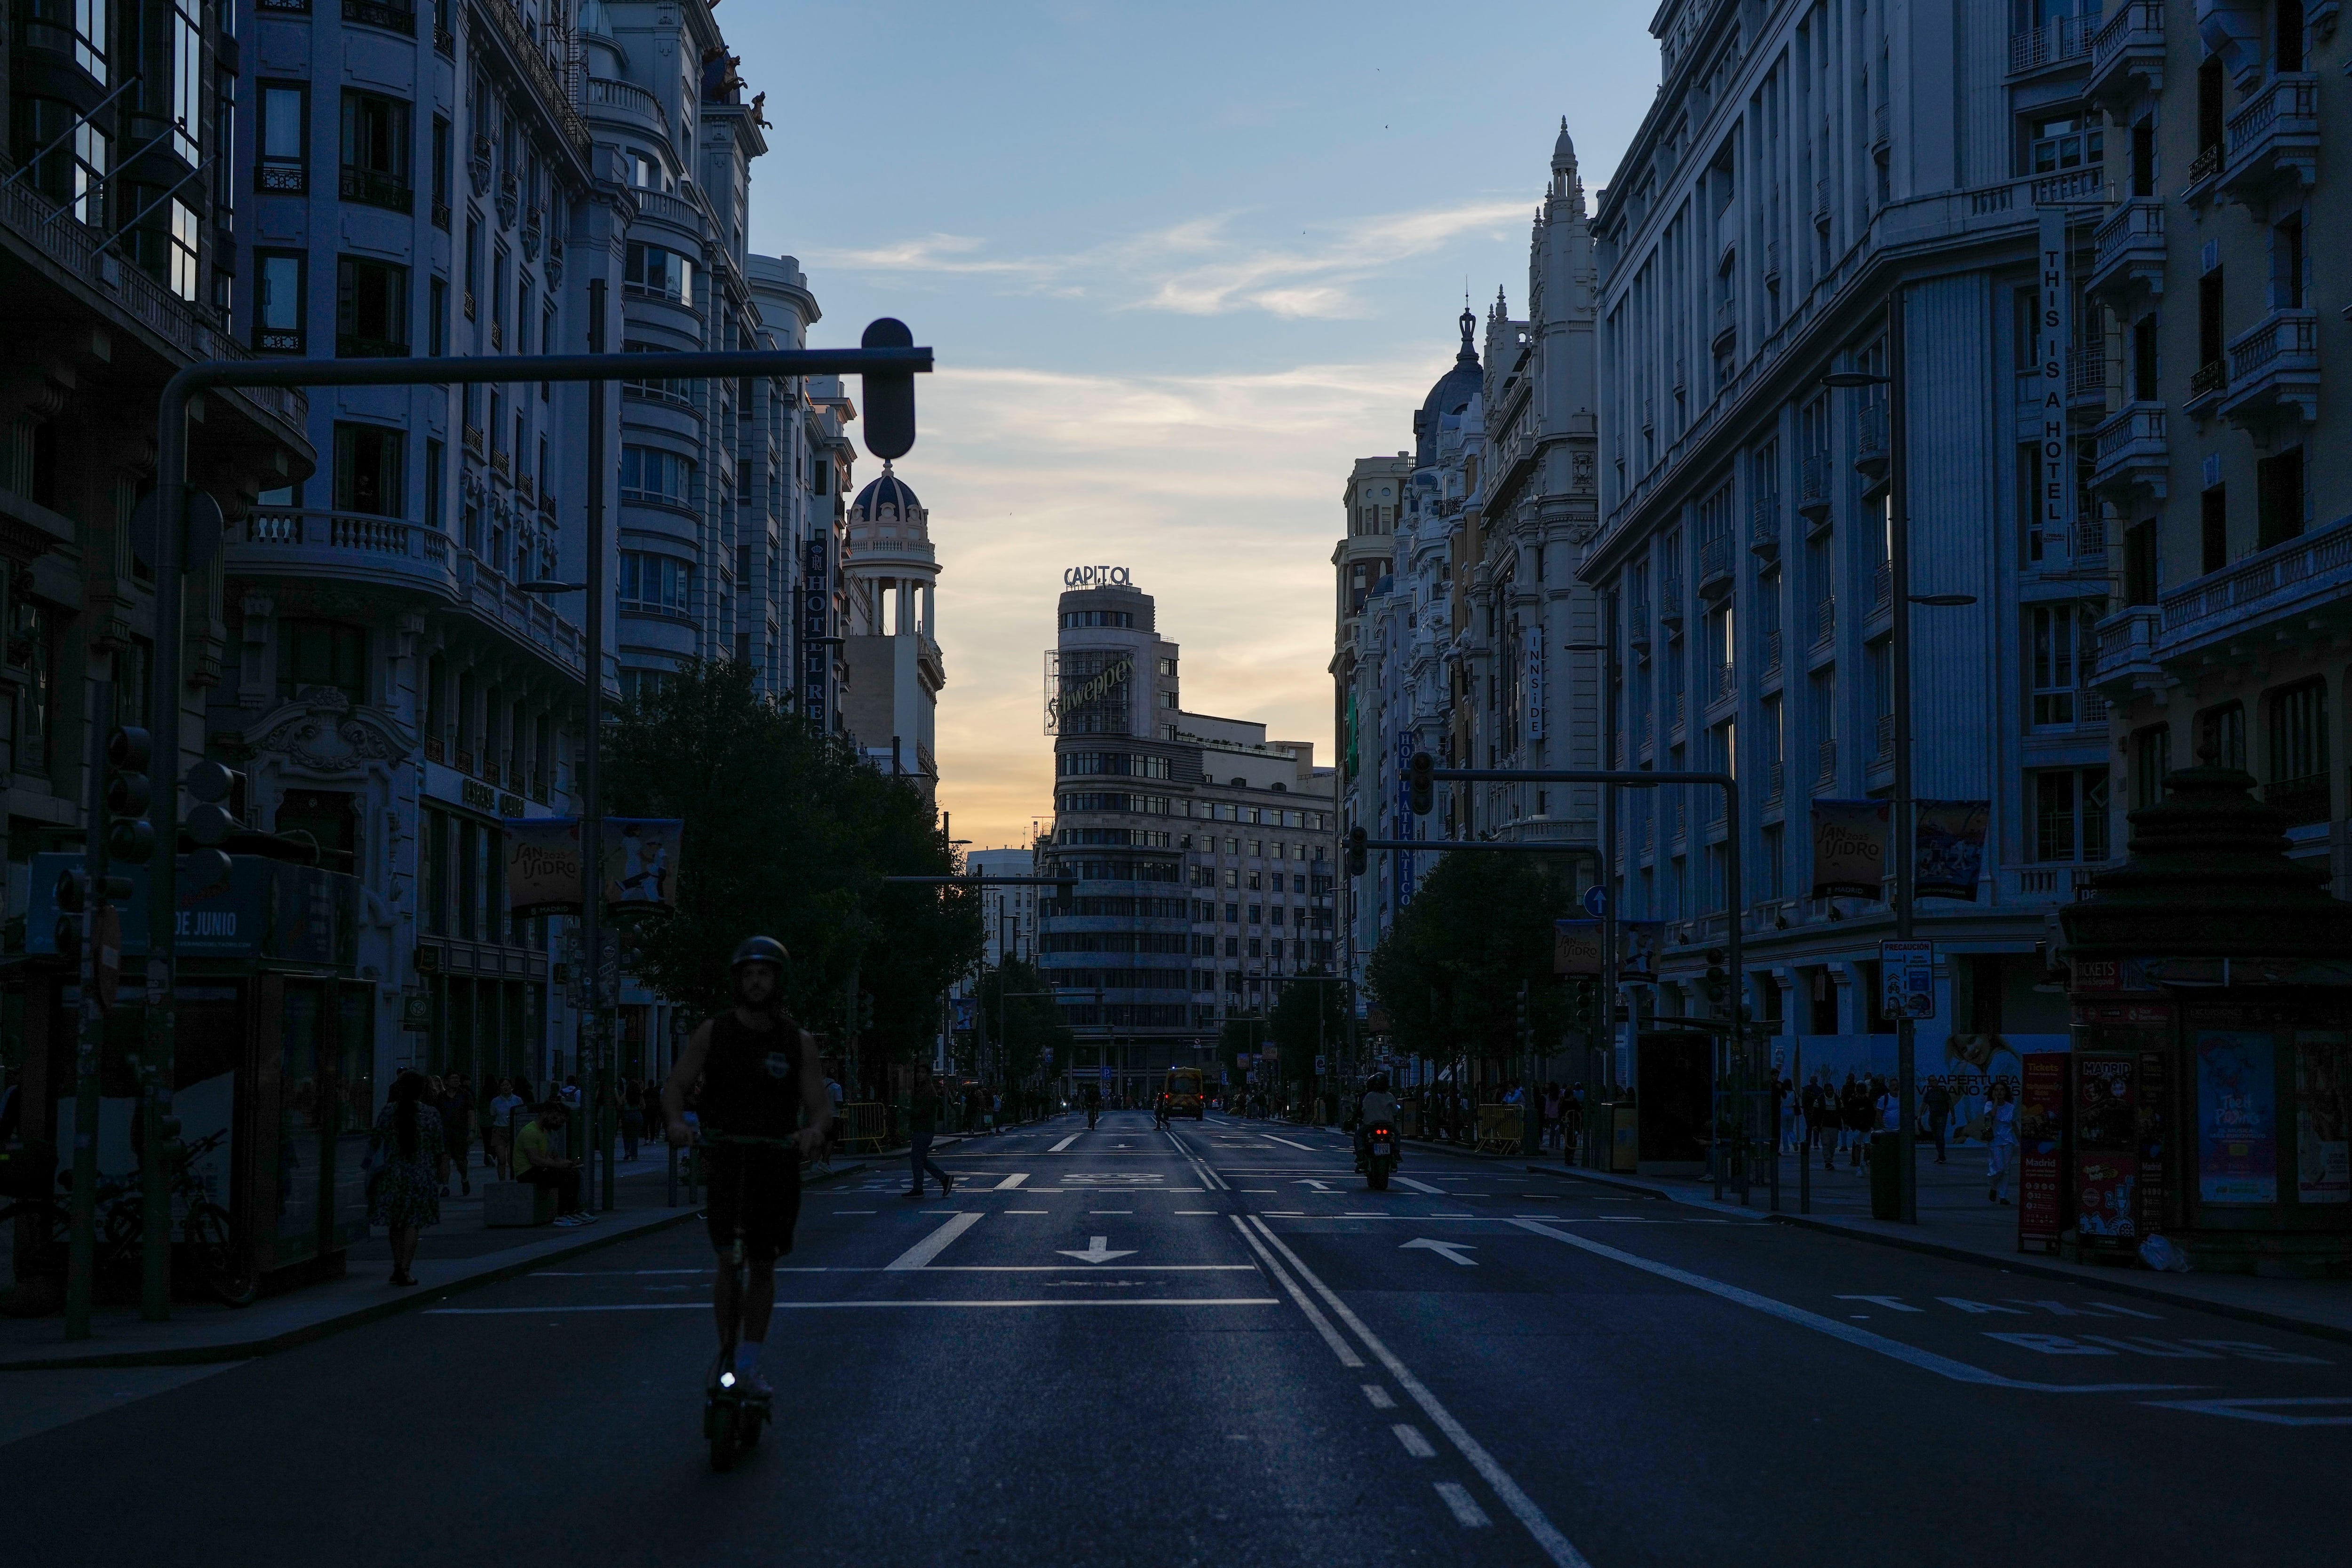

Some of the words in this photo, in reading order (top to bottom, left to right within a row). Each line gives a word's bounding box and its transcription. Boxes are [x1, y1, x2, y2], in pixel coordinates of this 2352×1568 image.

[2044, 251, 2059, 327] THIS
[2046, 340, 2060, 379] IS
[2045, 391, 2061, 408] A
[2046, 421, 2062, 520] HOTEL
[1064, 565, 1133, 586] CAPITOL
[807, 576, 826, 673] HOTEL
[1048, 653, 1136, 729] Schweppes
[1400, 734, 1411, 792] HOTL
[463, 778, 495, 809] ESPASA
[1817, 822, 1846, 844] SAN
[511, 842, 542, 865] SAN
[1826, 838, 1879, 861] ISIDRO
[523, 858, 576, 879] ISIDRO
[194, 911, 236, 936] JUNIO
[1557, 934, 1576, 948] SAN
[1563, 944, 1597, 958] ISIDRO
[1884, 942, 1930, 951] PRECAUCIÓN
[2026, 1063, 2059, 1072] Tickets
[2083, 1061, 2132, 1076] MADRID
[1915, 1085, 1980, 1096] VANO
[1983, 1085, 2021, 1096] 25
[1937, 1075, 2021, 1085] APERTURA
[2026, 1157, 2056, 1167] Madrid
[1833, 1294, 2166, 1320] TAXI
[1979, 1331, 2337, 1365] BUS
